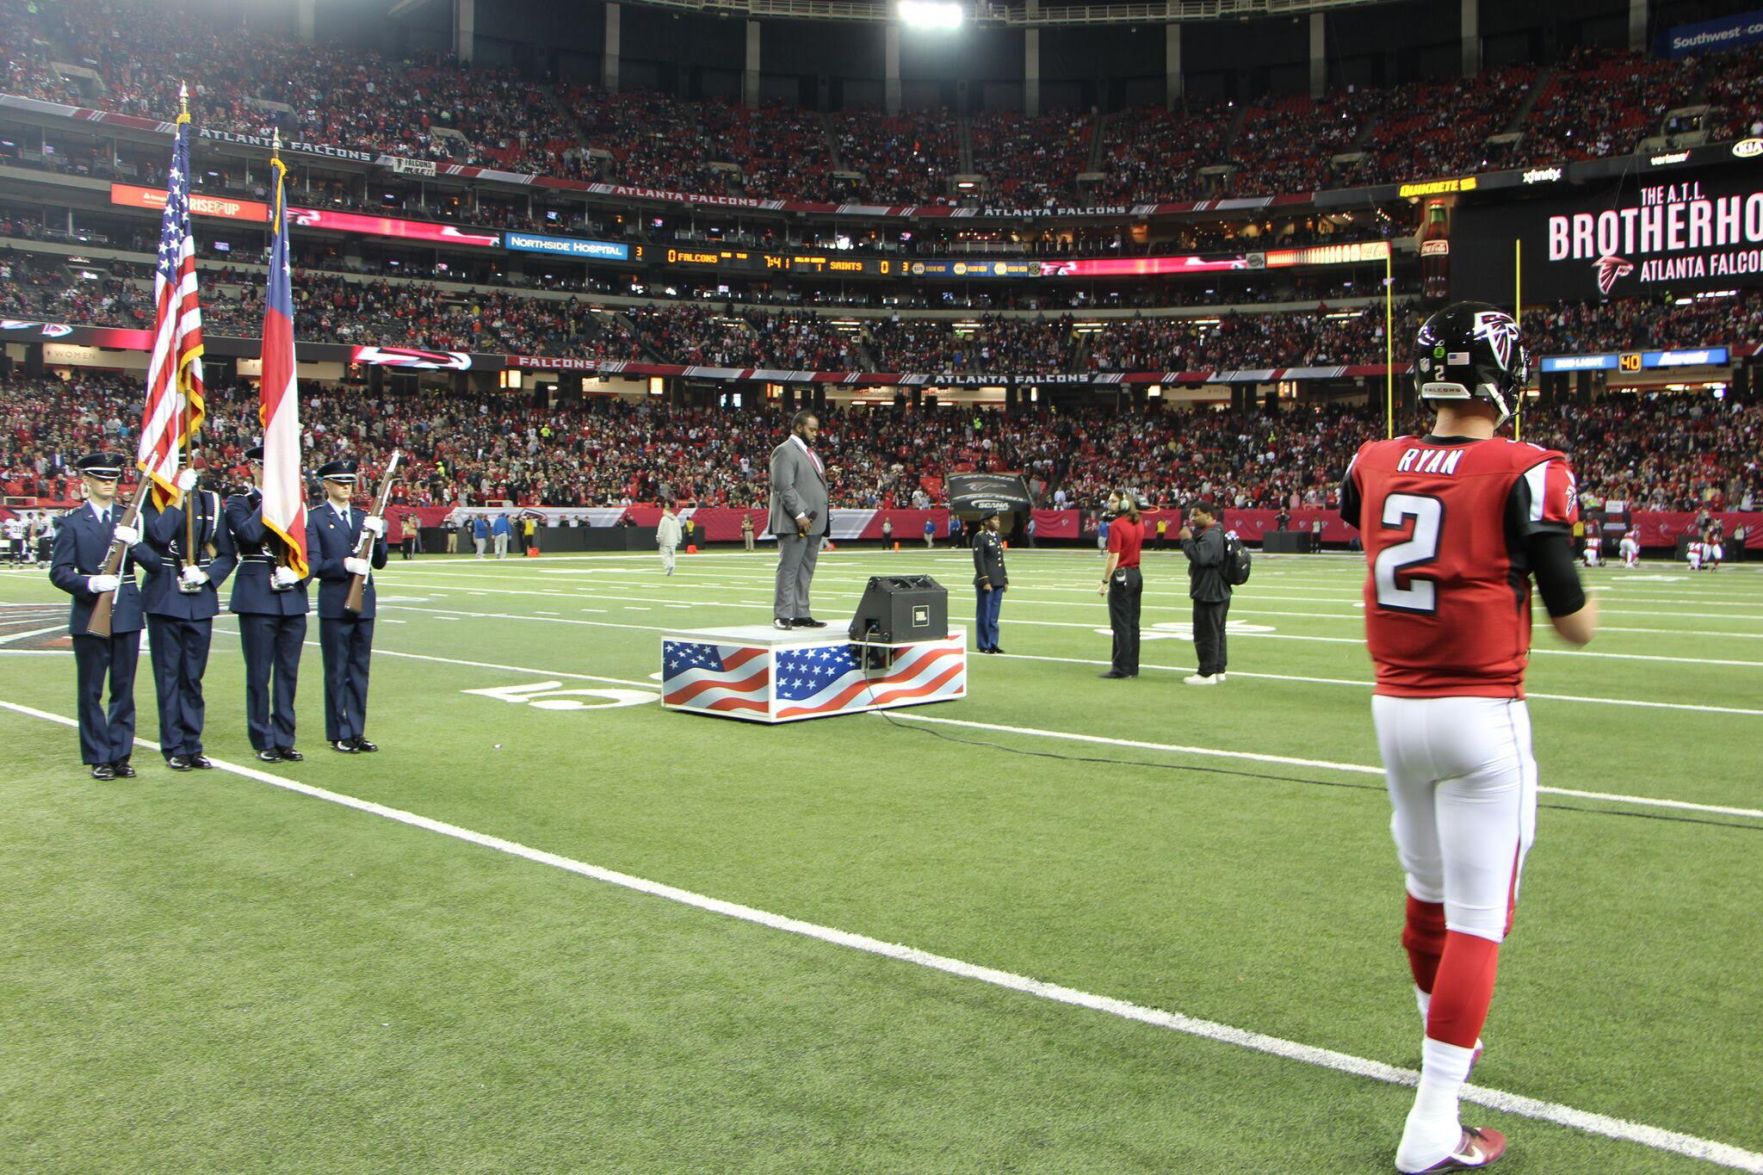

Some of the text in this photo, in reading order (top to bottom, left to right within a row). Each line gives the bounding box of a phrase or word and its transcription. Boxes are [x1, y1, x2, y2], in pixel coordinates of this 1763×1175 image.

[1673, 27, 1740, 49] Southwest
[291, 142, 371, 161] FALCONS
[617, 186, 758, 207] ATLANTA FALCONS
[1400, 180, 1460, 197] QUIKRETE
[1641, 181, 1705, 206] THE A.T.L.
[189, 197, 240, 216] RISE UP
[984, 206, 1126, 217] ATLANTA FALCONS
[1549, 193, 1763, 261] BROTHERHO
[511, 236, 622, 256] NORTHSIDE HOSPITAL
[678, 252, 718, 264] FALCONS
[830, 261, 863, 272] SAINTS
[1640, 249, 1763, 283] ATLANTA FALCO
[519, 357, 596, 369] FALCONS
[1620, 354, 1640, 371] 40
[935, 374, 1089, 384] ATLANTA FALCONS
[1434, 364, 1446, 381] 2
[1397, 448, 1465, 475] RYAN
[1374, 492, 1445, 614] 2
